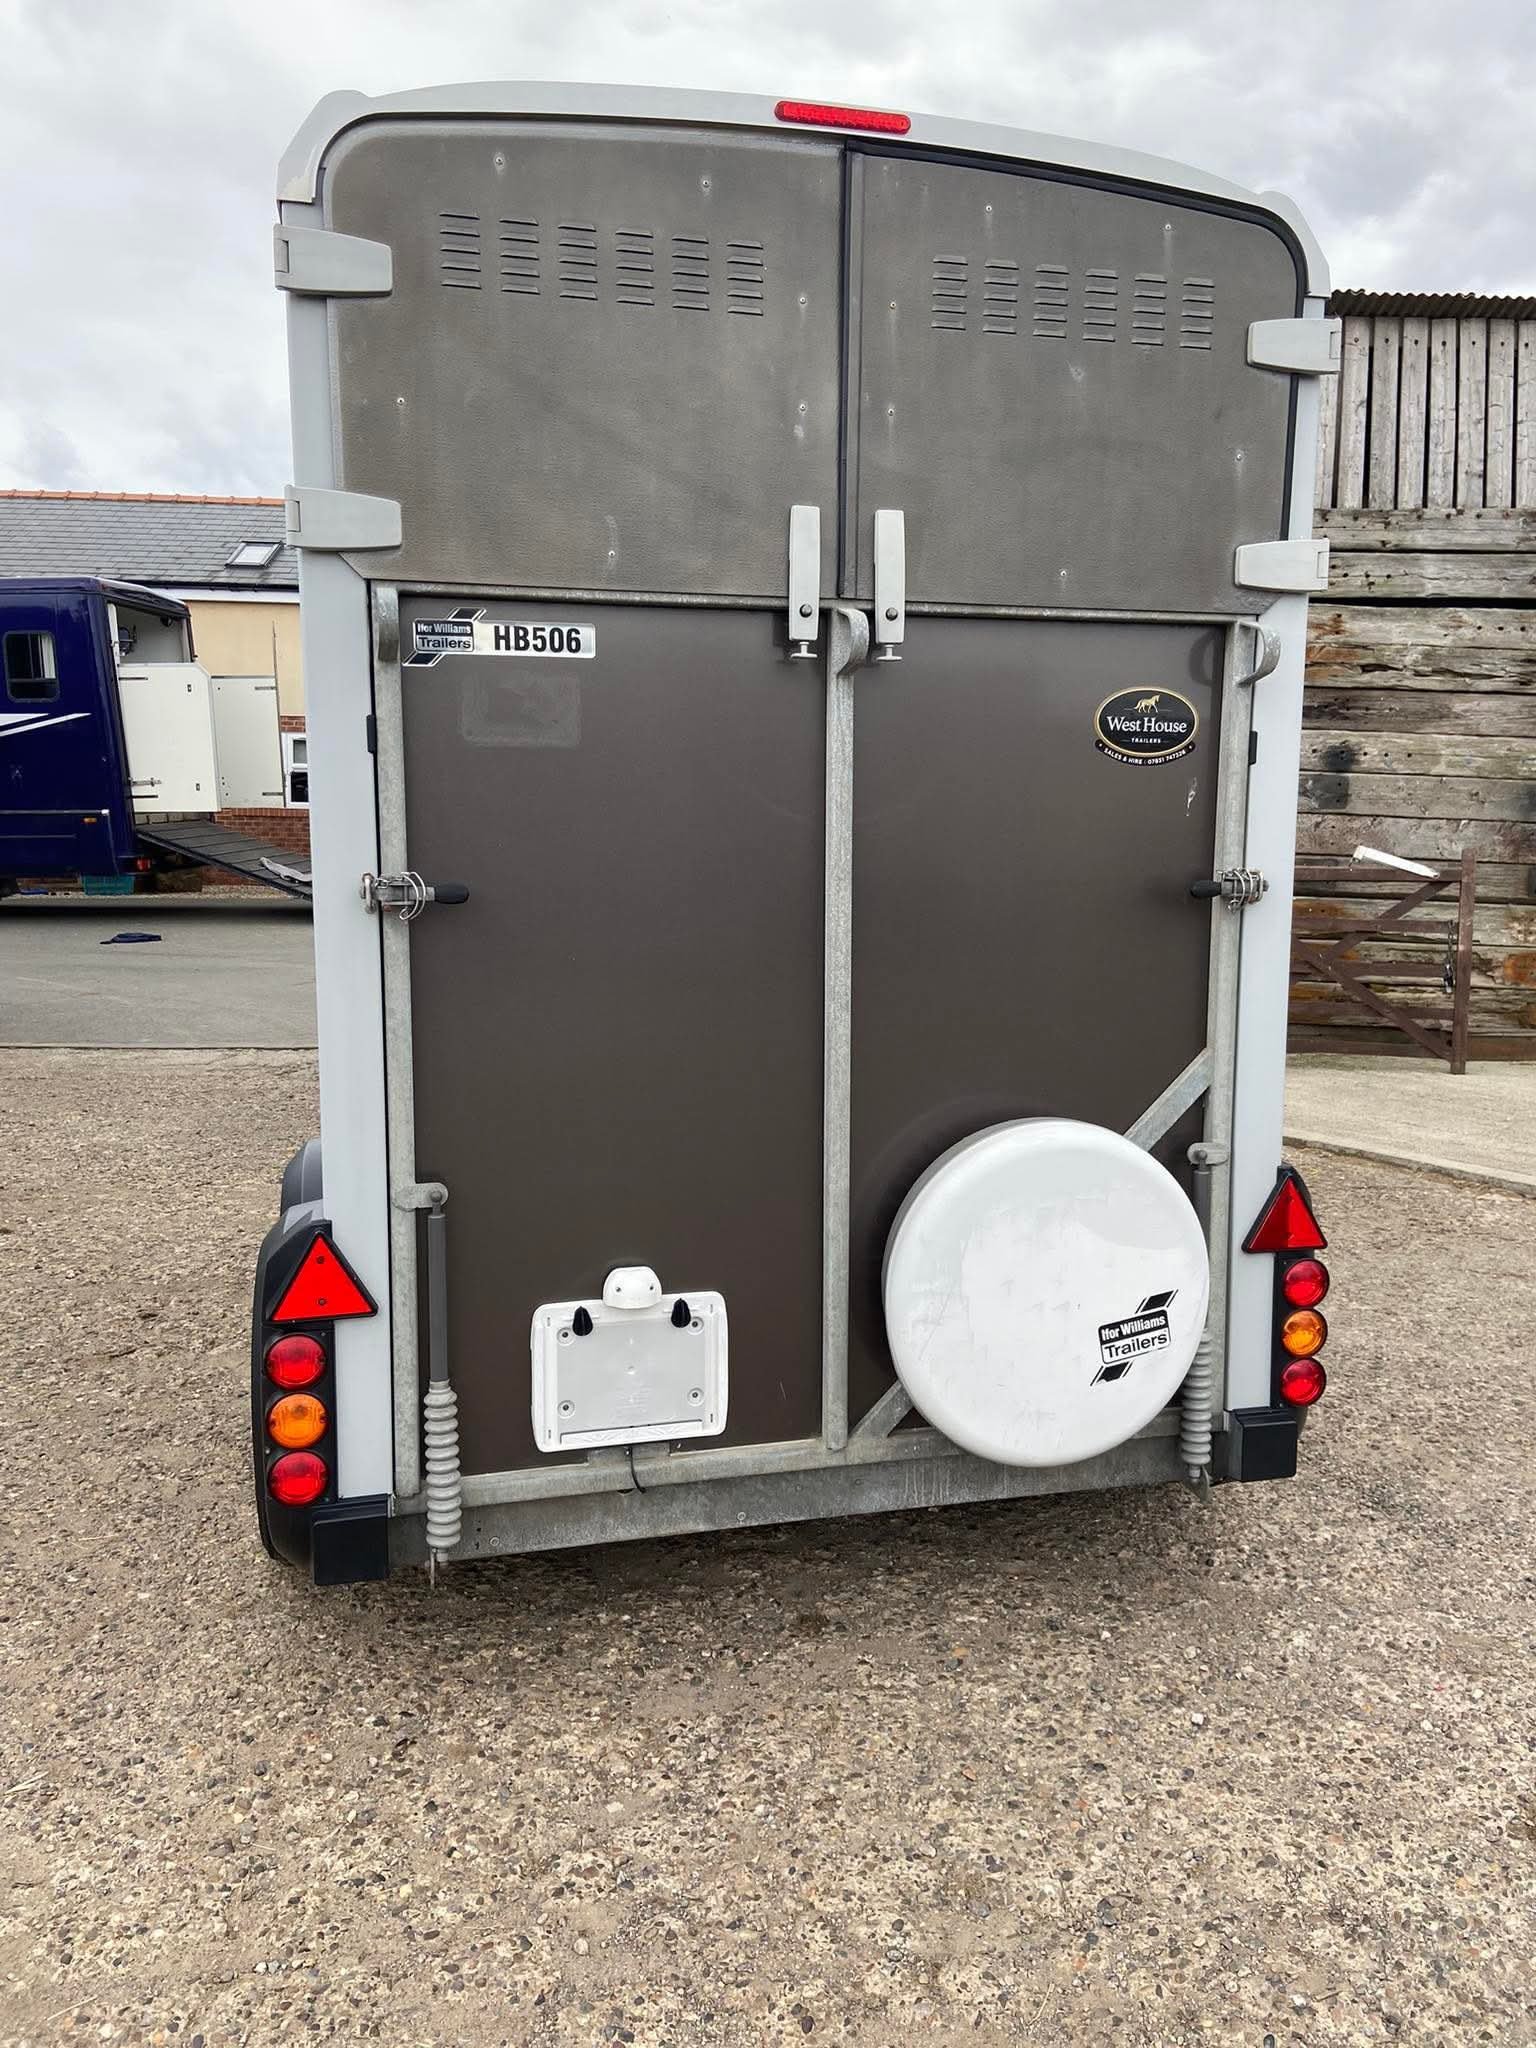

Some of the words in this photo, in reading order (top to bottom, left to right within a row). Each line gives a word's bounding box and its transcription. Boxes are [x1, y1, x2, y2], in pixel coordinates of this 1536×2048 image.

[417, 623, 432, 633] Ifor
[433, 623, 471, 634] Williams
[418, 637, 471, 648] Trailers
[494, 625, 581, 653] HB506
[1106, 716, 1141, 731] West
[1143, 717, 1187, 733] House
[1103, 747, 1122, 760] SALES
[1128, 757, 1142, 765] HIRE
[1101, 1327, 1120, 1341] Ifor
[1119, 1315, 1166, 1336] Williams
[1104, 1333, 1168, 1358] Trailers
